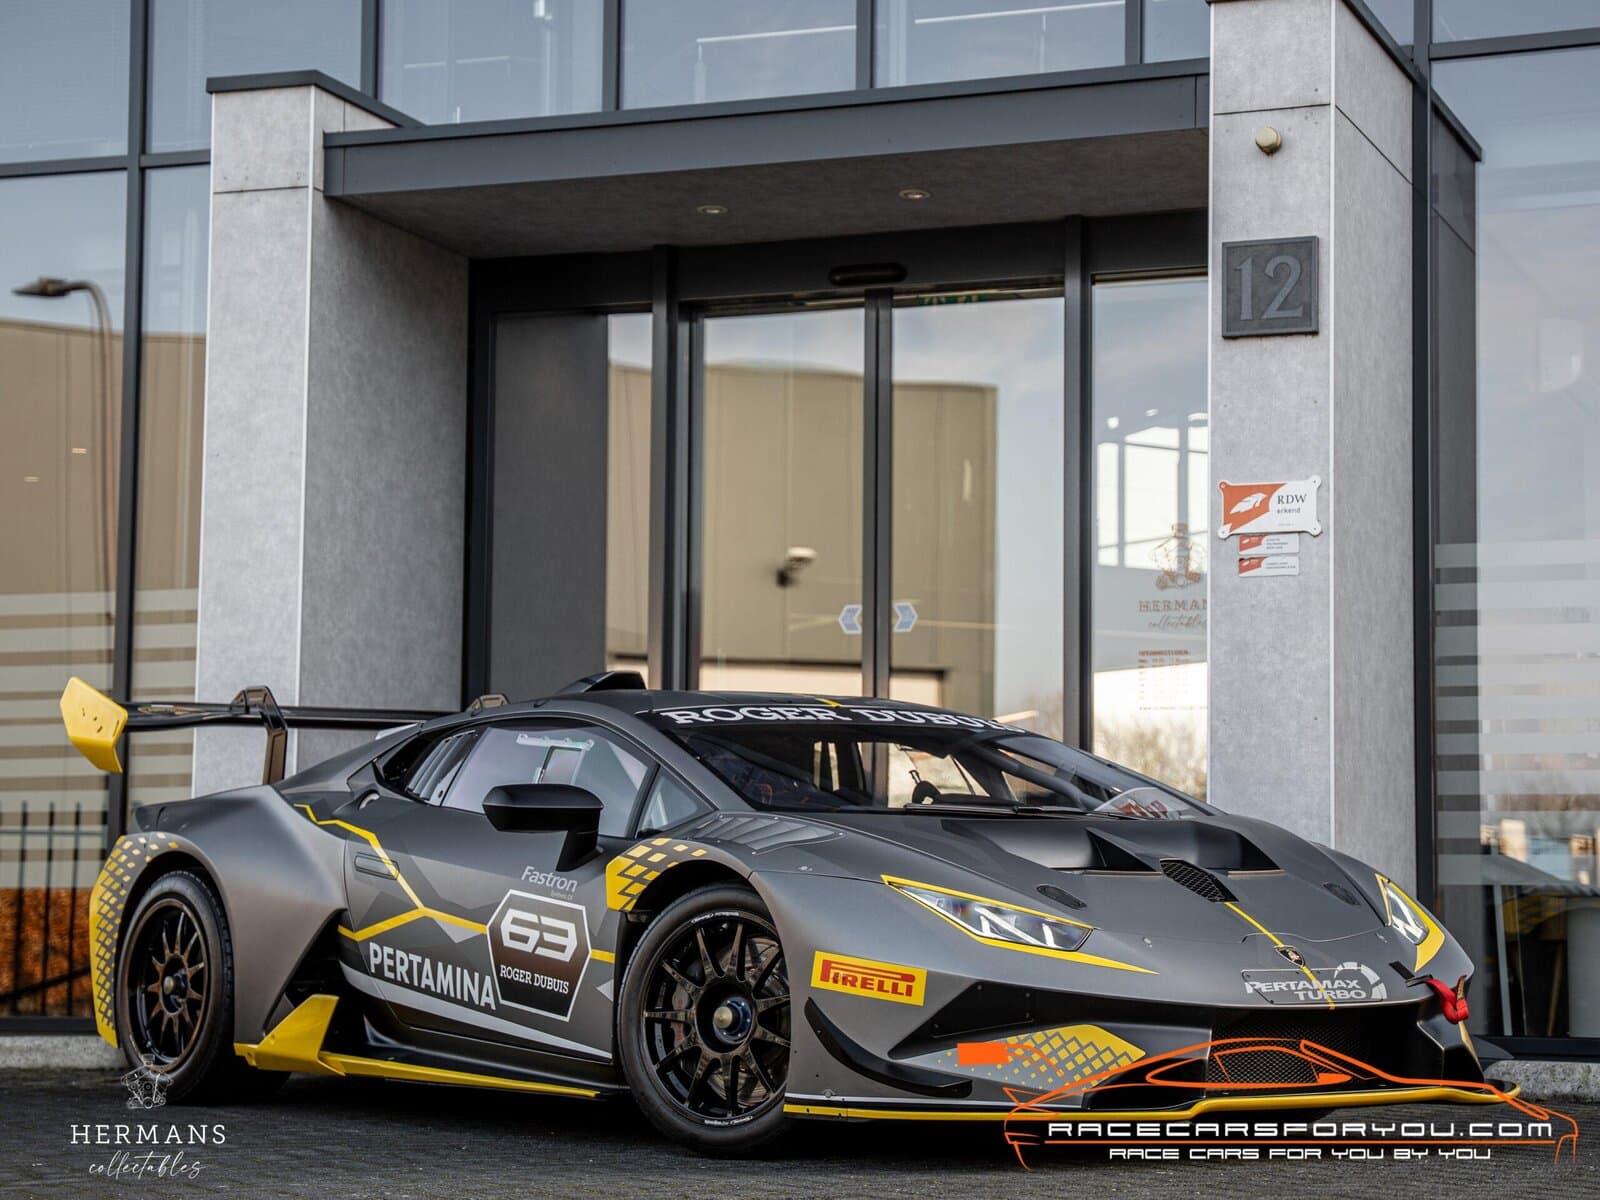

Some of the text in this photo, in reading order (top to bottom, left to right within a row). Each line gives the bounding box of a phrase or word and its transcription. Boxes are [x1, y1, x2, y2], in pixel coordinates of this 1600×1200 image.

[1233, 255, 1304, 321] 12
[1277, 494, 1307, 505] RDW
[661, 707, 847, 724] ROGER
[521, 866, 578, 893] Fastron
[500, 908, 578, 962] 63
[369, 942, 496, 1011] PERTAMINA
[500, 964, 569, 995] ROGER DUBUIS
[820, 959, 916, 997] PIRELLI
[1245, 979, 1361, 994] PERTAMAX
[1294, 990, 1367, 1001] TURBO
